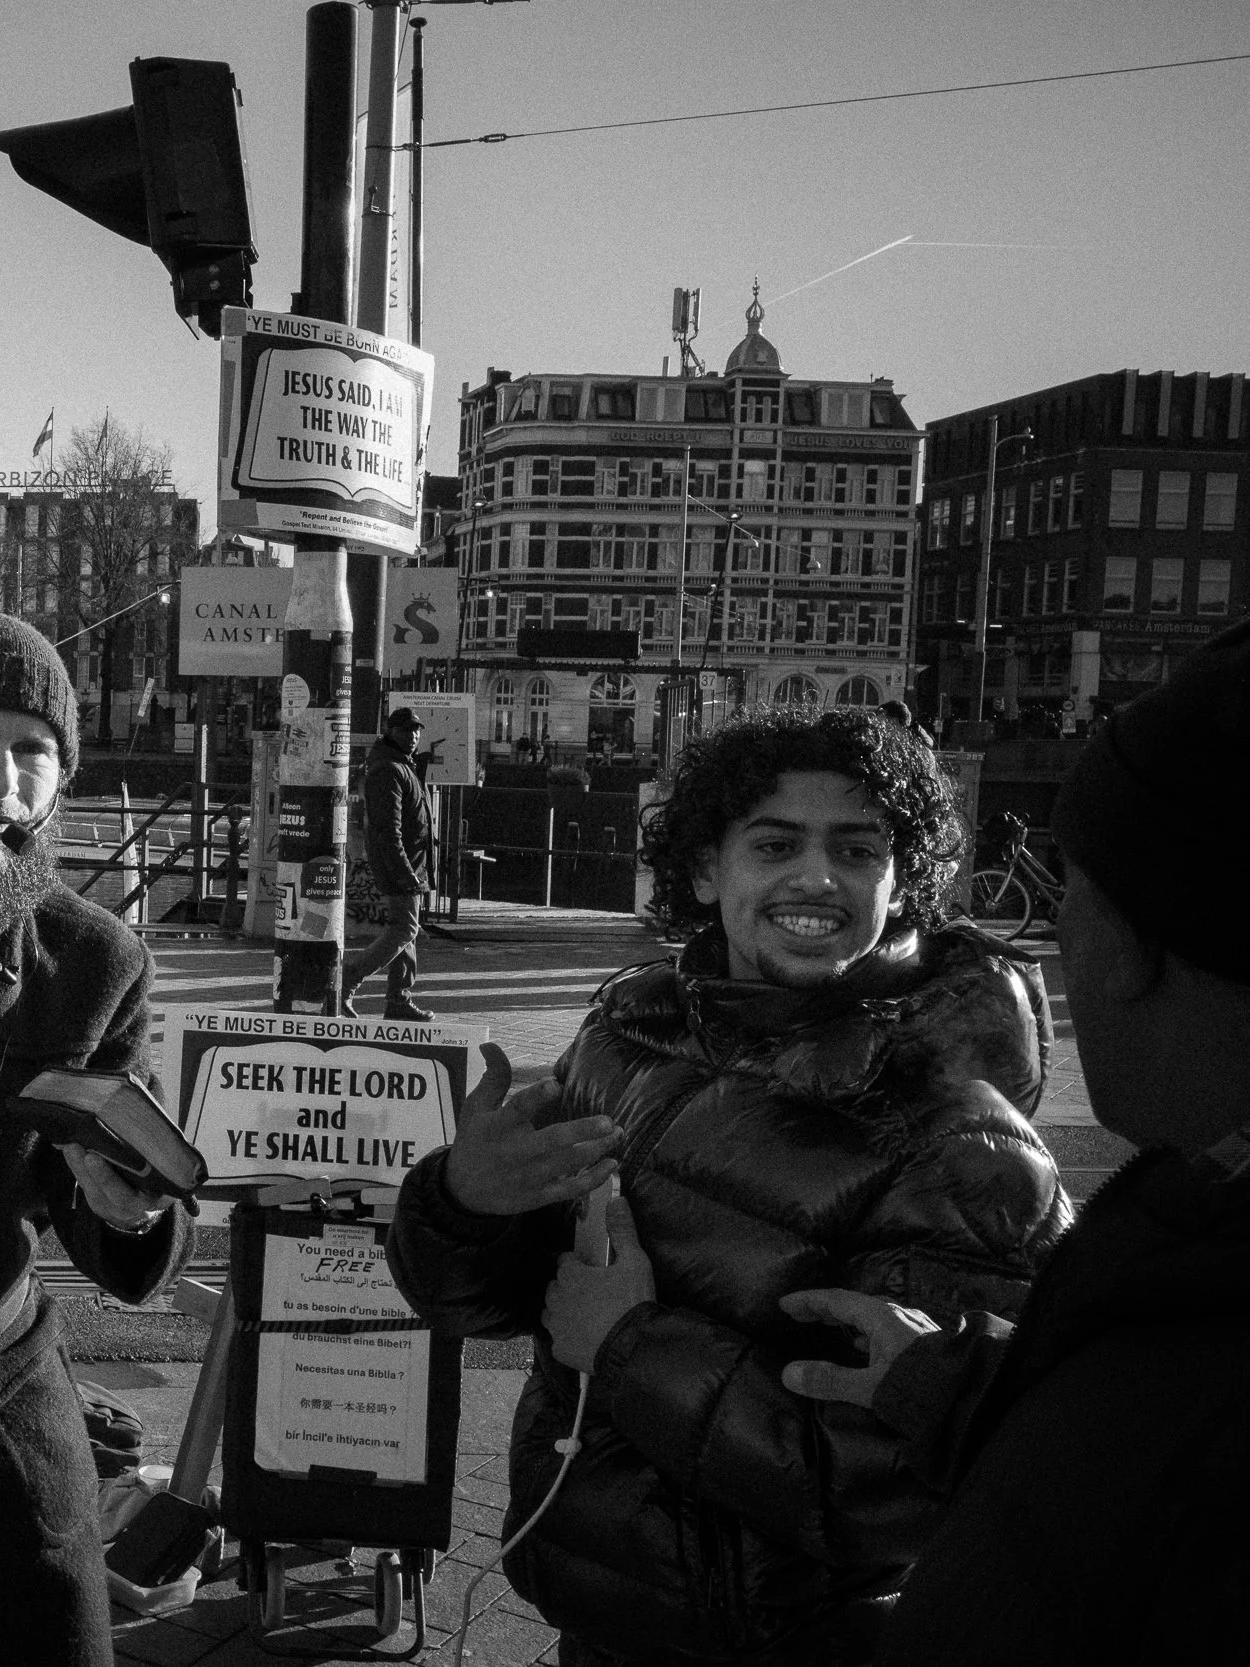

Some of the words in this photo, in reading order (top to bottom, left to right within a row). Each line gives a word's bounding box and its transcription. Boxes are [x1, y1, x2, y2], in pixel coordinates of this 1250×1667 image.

[277, 319, 320, 339] MUST
[282, 369, 334, 400] JESUS
[337, 379, 376, 412] SAID,
[379, 389, 383, 411] I
[300, 405, 333, 433] THE
[337, 411, 368, 440] WAY
[371, 419, 393, 447] THE
[790, 434, 830, 447] JESUS
[277, 435, 337, 467] TRUTH
[341, 445, 352, 470] &
[356, 448, 380, 476] THE
[382, 455, 403, 483] LIFE
[281, 520, 301, 529] Gospel
[330, 514, 342, 523] and
[194, 602, 279, 620] CANAL
[1144, 621, 1211, 634] Amsterdam
[700, 674, 717, 688] 37
[288, 829, 311, 838] vrede
[319, 864, 335, 873] only
[313, 876, 338, 884] JESUS
[305, 887, 325, 896] gives
[185, 1013, 218, 1031] “YE
[224, 1016, 278, 1034] MUST
[281, 1020, 308, 1036] BE
[312, 1021, 368, 1039] BORN
[372, 1025, 442, 1044] AGAIN”
[220, 1061, 285, 1093] SEEK
[292, 1065, 343, 1097] THE
[349, 1069, 428, 1101] LORD
[296, 1100, 348, 1130] and
[226, 1129, 260, 1160] YE
[265, 1131, 350, 1165] SHALL
[356, 1137, 416, 1169] LIVE
[297, 1242, 321, 1256] You
[324, 1247, 354, 1258] need
[357, 1250, 365, 1259] a
[315, 1257, 376, 1273] FREE
[332, 1275, 355, 1285] الكتاب
[283, 1300, 294, 1310] tu
[296, 1302, 309, 1311] as
[311, 1301, 347, 1314] besoin
[349, 1305, 378, 1316] d'une
[380, 1307, 407, 1319] bible
[292, 1332, 306, 1341] du
[307, 1333, 352, 1345] brauchst
[353, 1337, 375, 1346] eine
[295, 1362, 345, 1376] Necesitas
[347, 1368, 366, 1377] una
[368, 1368, 397, 1380] Biblia
[398, 1371, 405, 1381] ?
[285, 1429, 301, 1440] bir
[302, 1428, 334, 1443] İncil'e
[336, 1432, 381, 1448] ihtiyacın
[383, 1438, 401, 1449] var
